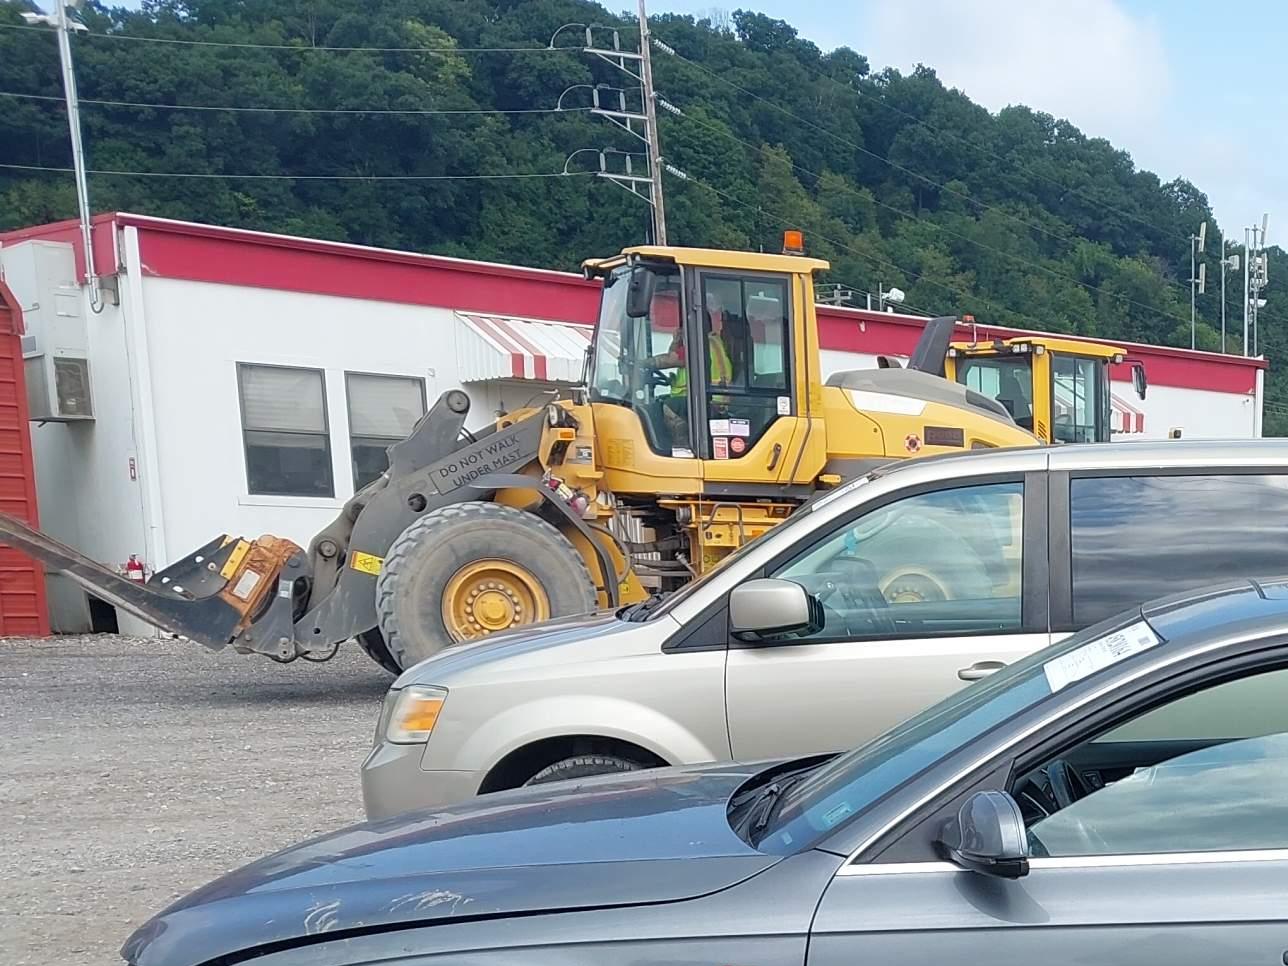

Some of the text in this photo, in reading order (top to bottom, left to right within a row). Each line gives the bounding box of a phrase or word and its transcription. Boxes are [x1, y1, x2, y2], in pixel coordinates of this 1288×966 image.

[439, 434, 520, 478] DO NOT WALK
[453, 448, 521, 487] UNDER MAST
